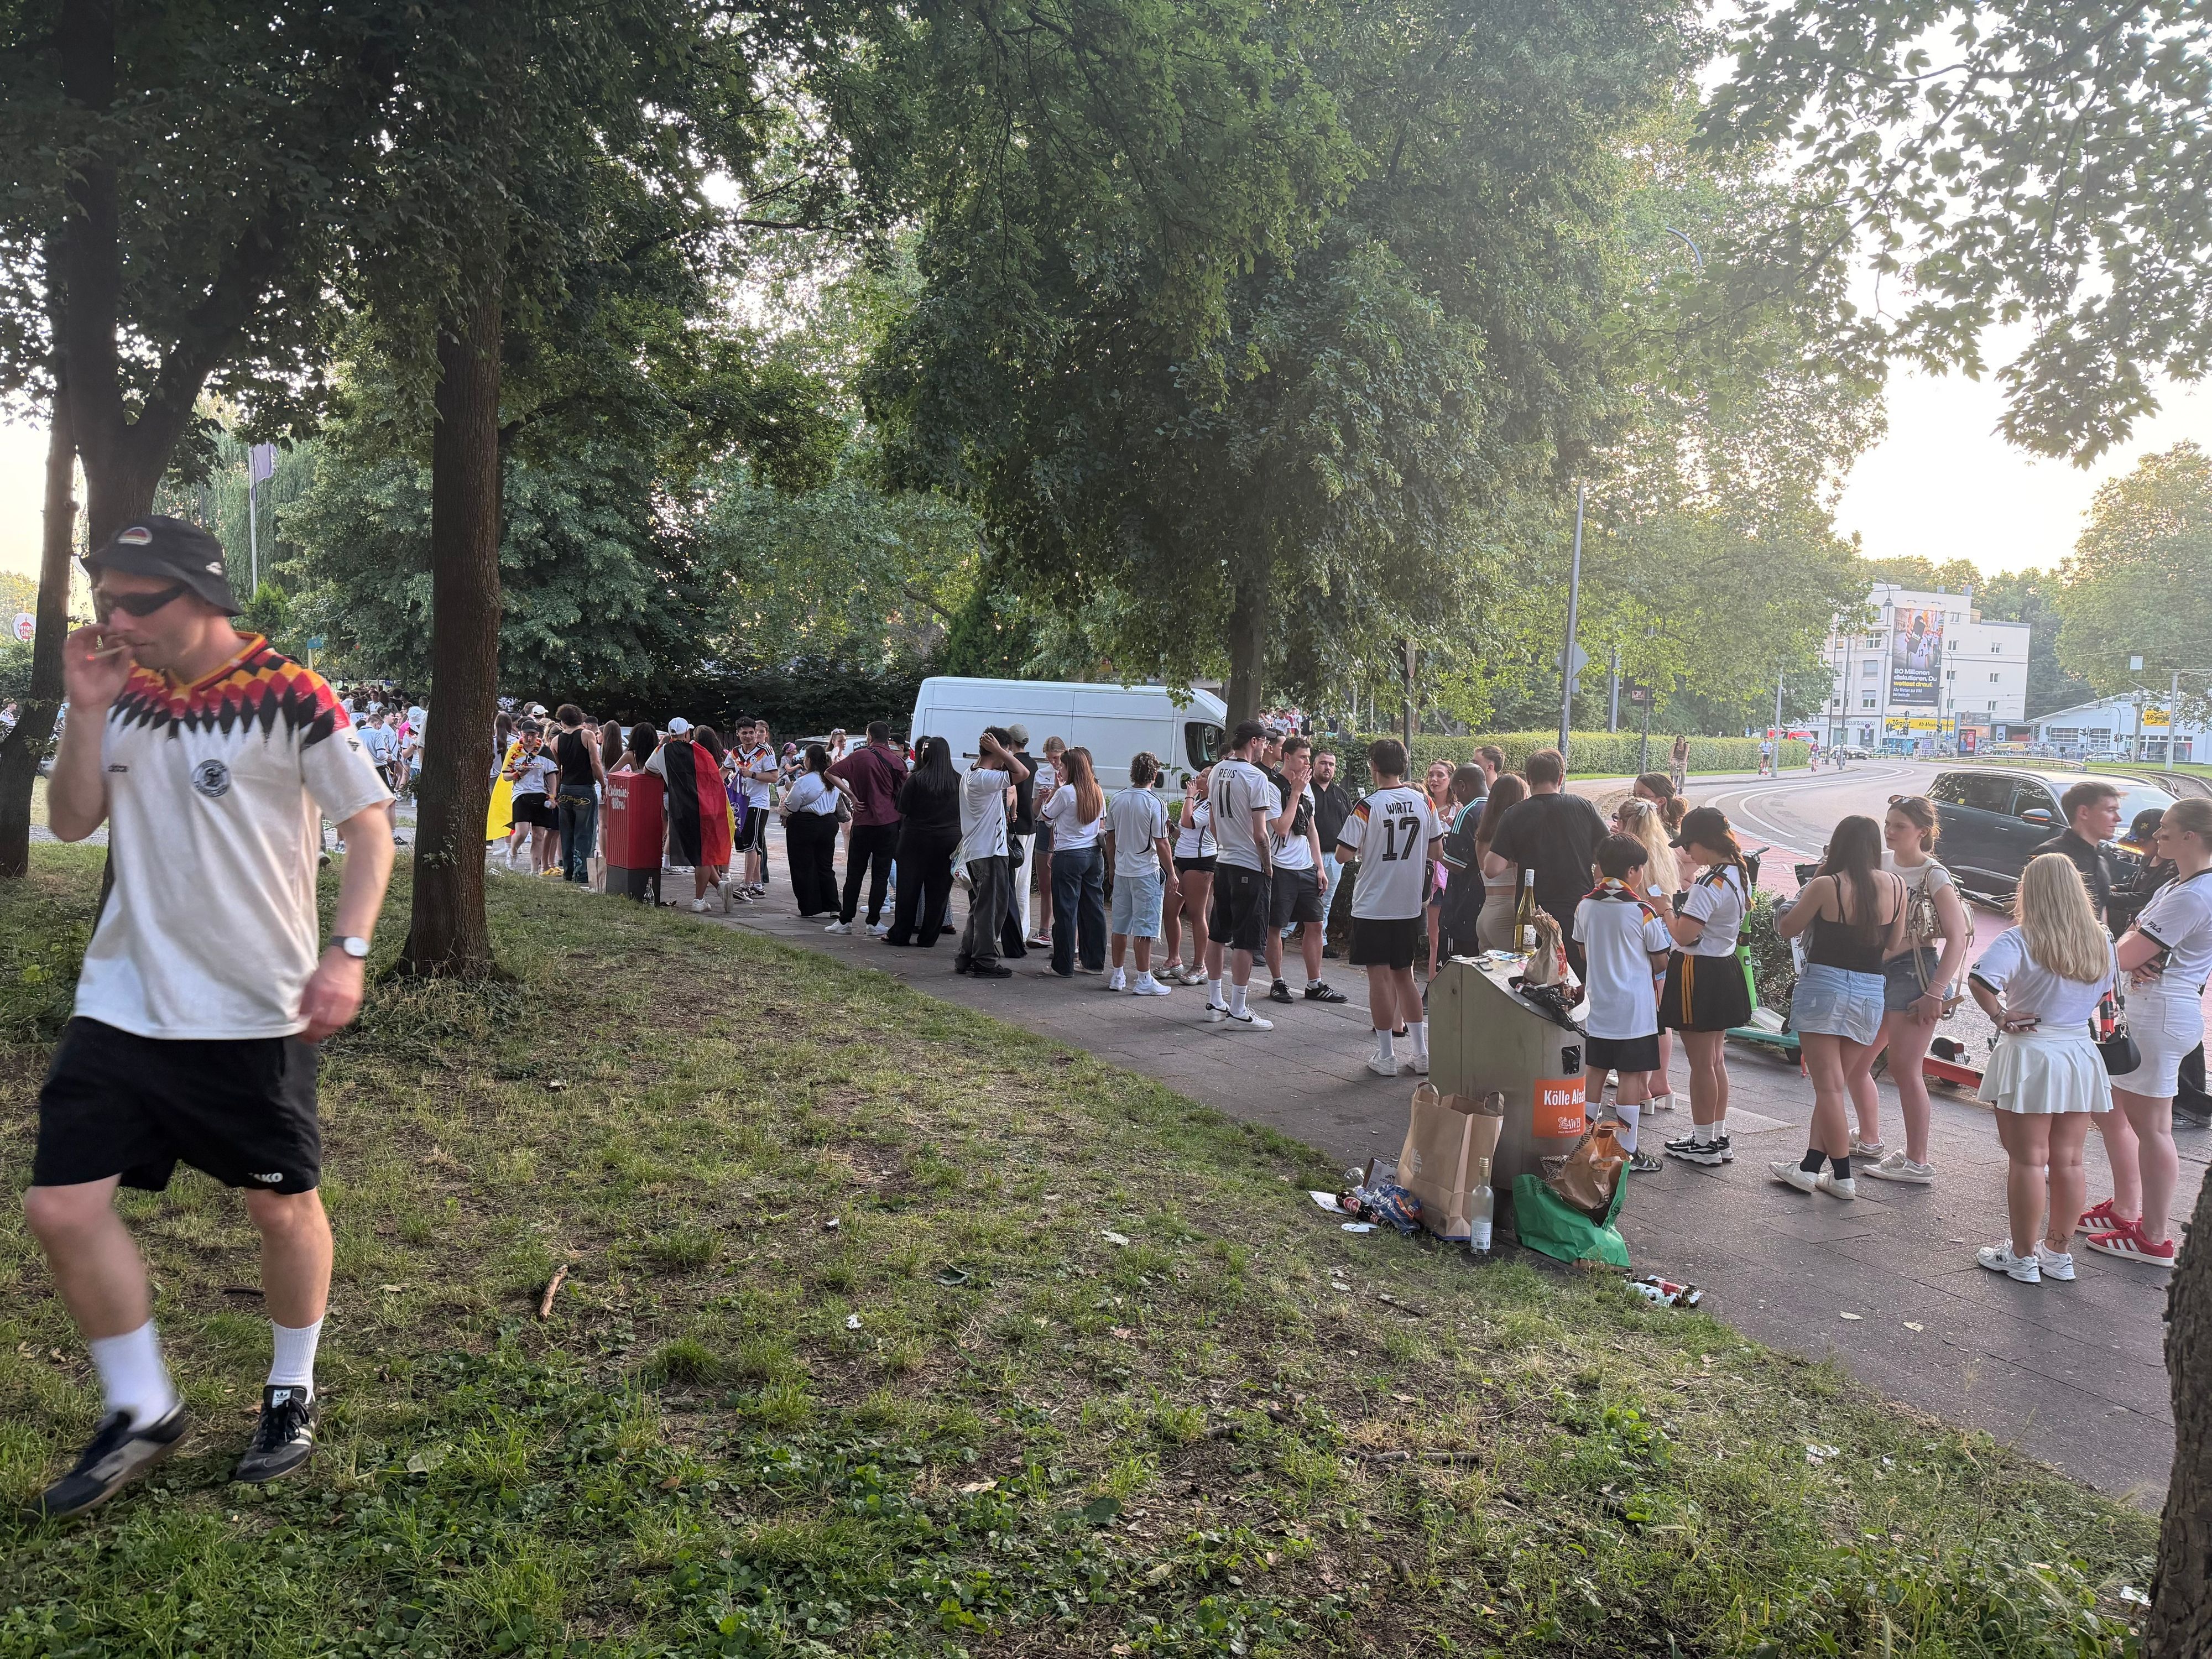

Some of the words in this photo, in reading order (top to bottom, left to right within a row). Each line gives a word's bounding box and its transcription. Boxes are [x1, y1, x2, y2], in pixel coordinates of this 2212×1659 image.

[1218, 768, 1237, 779] REUS
[1218, 780, 1233, 818] 11
[1385, 801, 1414, 815] WIRTZ
[1383, 816, 1420, 862] 17
[2147, 921, 2162, 933] FILA
[1544, 1089, 1570, 1105] Kölle
[1566, 1117, 1580, 1129] AWB
